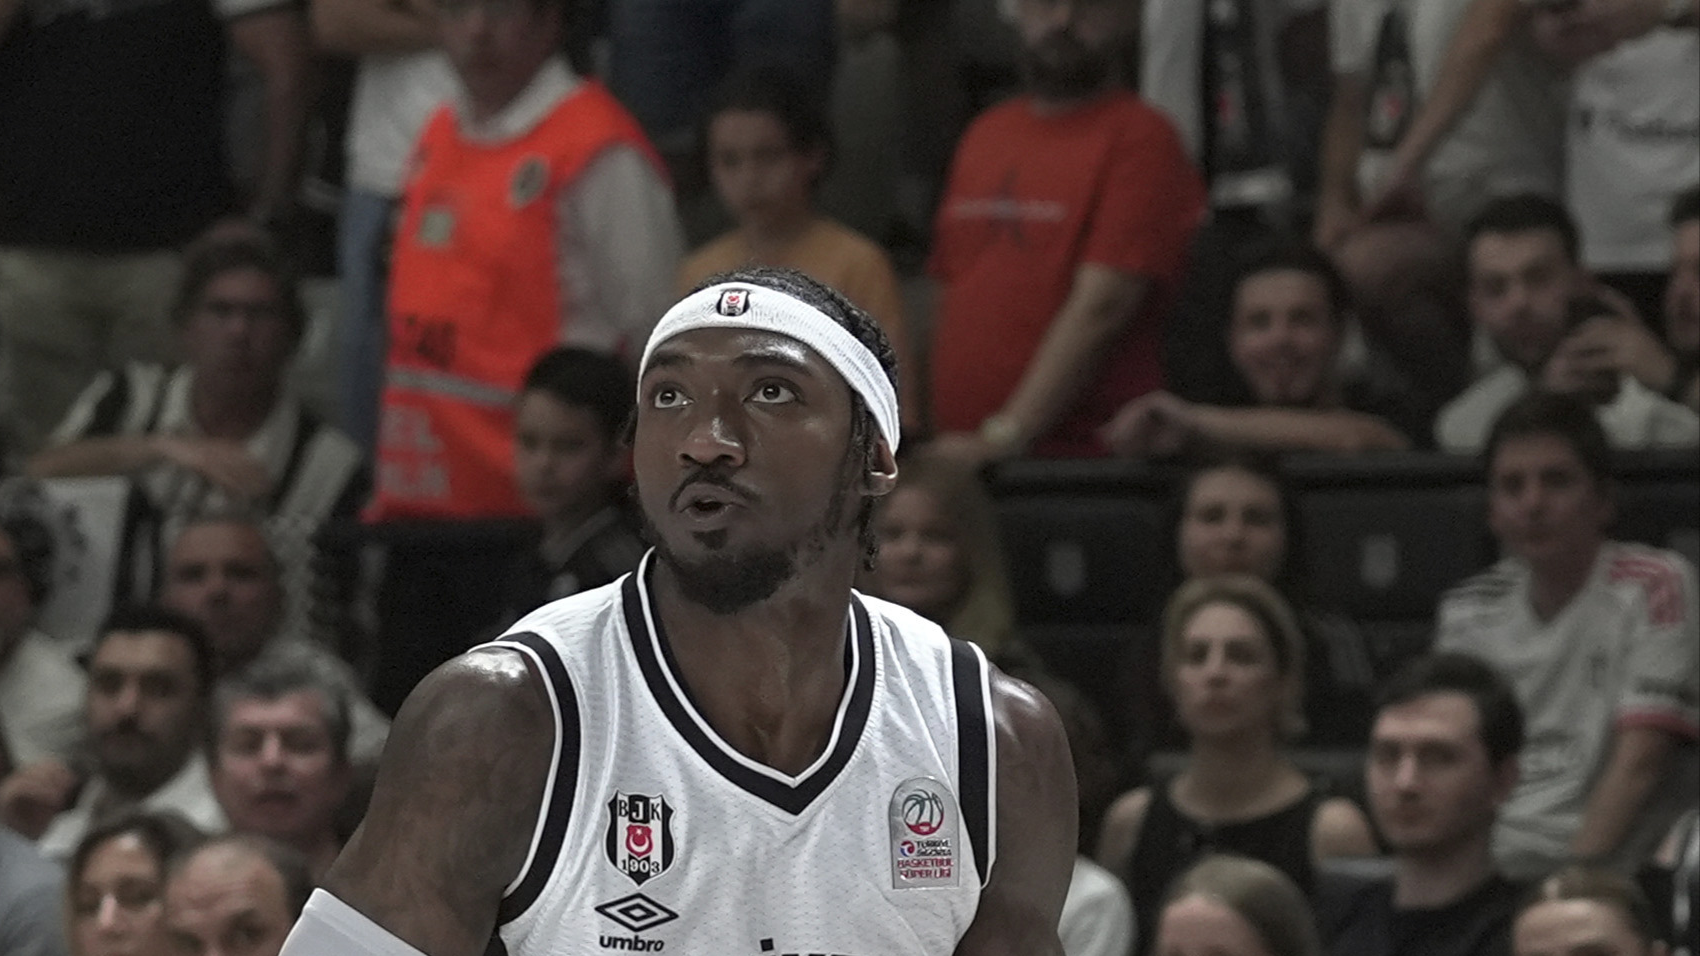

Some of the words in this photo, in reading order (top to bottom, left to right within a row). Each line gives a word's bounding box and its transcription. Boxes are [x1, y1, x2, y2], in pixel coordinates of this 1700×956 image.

[619, 799, 661, 821] BJK
[621, 858, 660, 873] 1903
[599, 934, 664, 952] umbro
